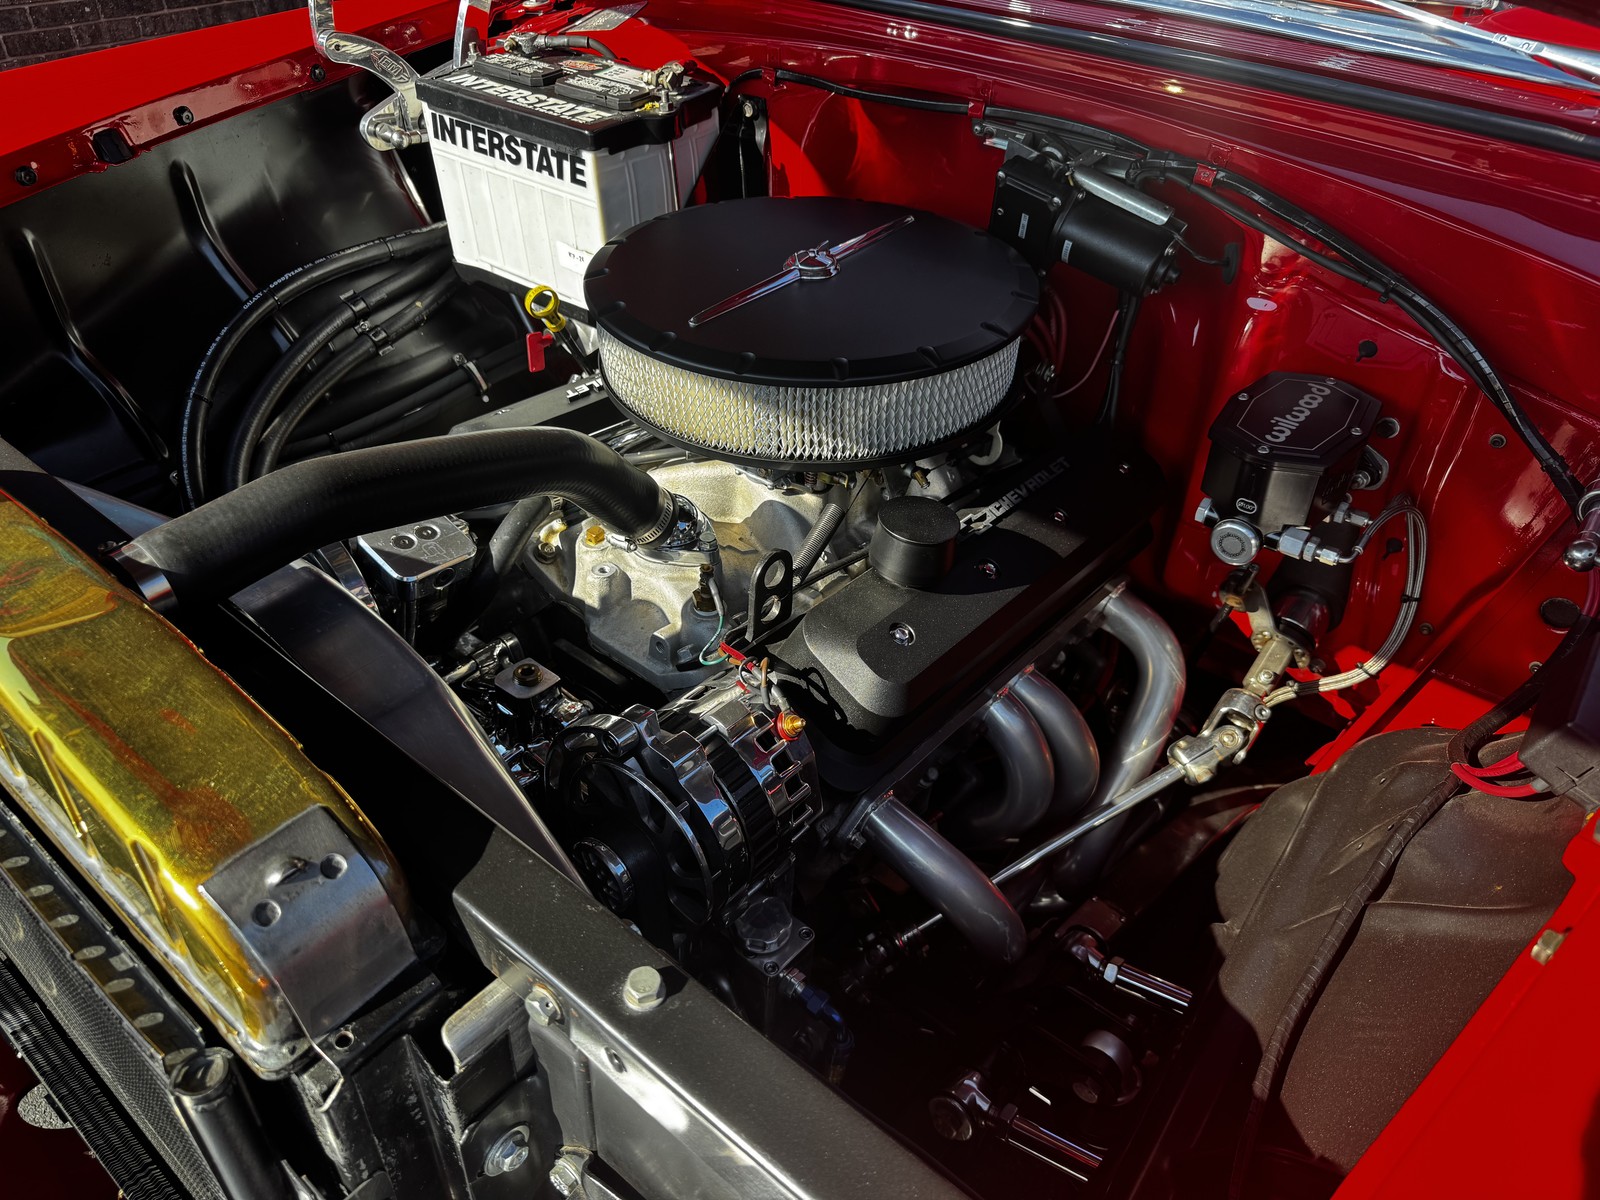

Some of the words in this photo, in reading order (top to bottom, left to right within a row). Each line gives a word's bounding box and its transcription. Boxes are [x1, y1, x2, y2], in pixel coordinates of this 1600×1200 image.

[444, 73, 613, 123] INTERSTATE
[431, 112, 587, 188] INTERSTATE
[243, 291, 264, 310] GALAXY
[1265, 383, 1331, 443] wilwood
[988, 456, 1071, 517] CHEVROLET
